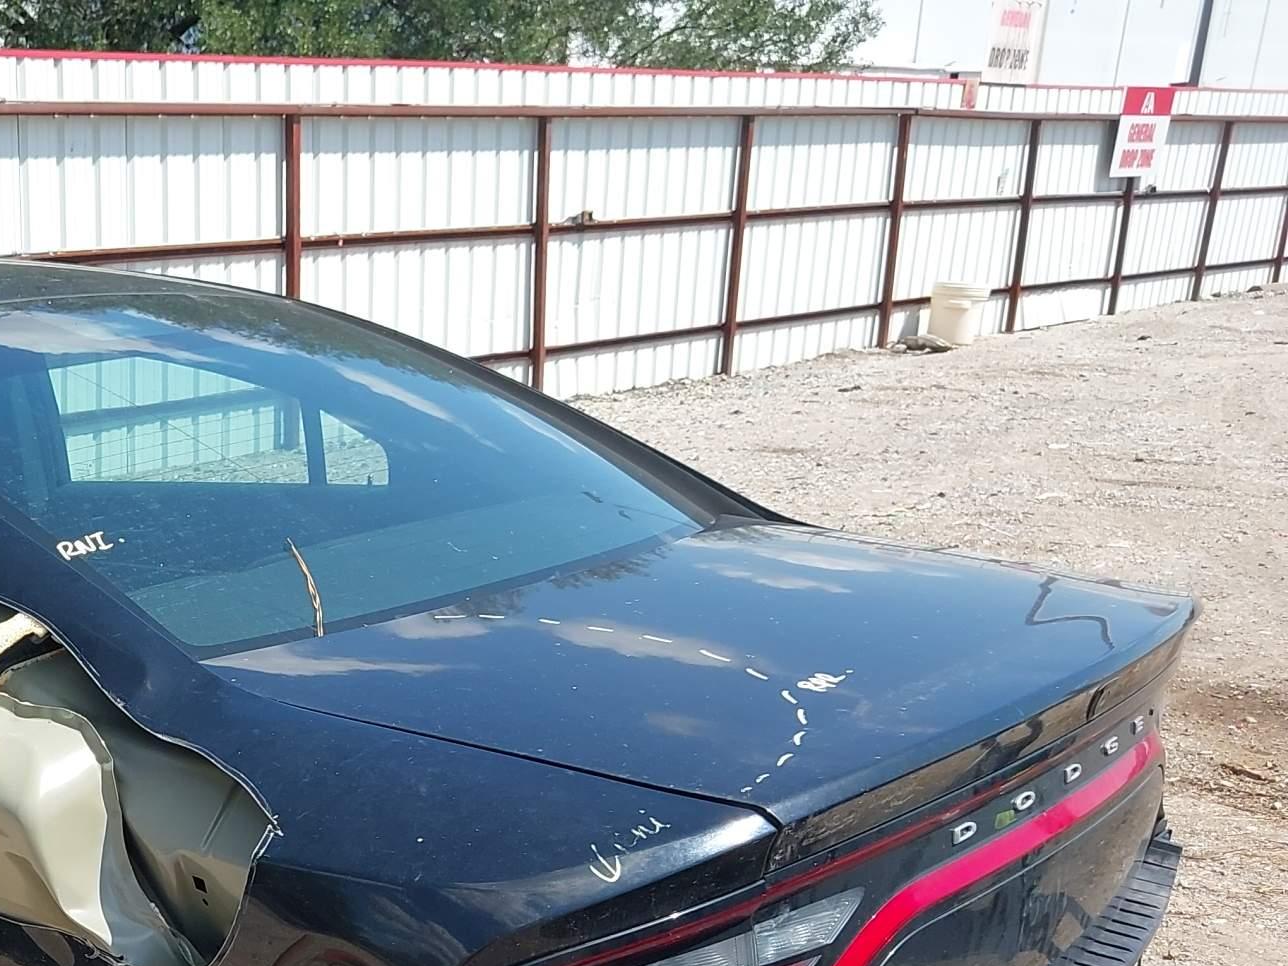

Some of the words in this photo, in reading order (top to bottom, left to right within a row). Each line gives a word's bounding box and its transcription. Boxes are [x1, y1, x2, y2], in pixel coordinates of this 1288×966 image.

[1127, 123, 1157, 143] GENERAL
[1119, 149, 1139, 169] DROP
[951, 715, 1145, 846] DODGE
